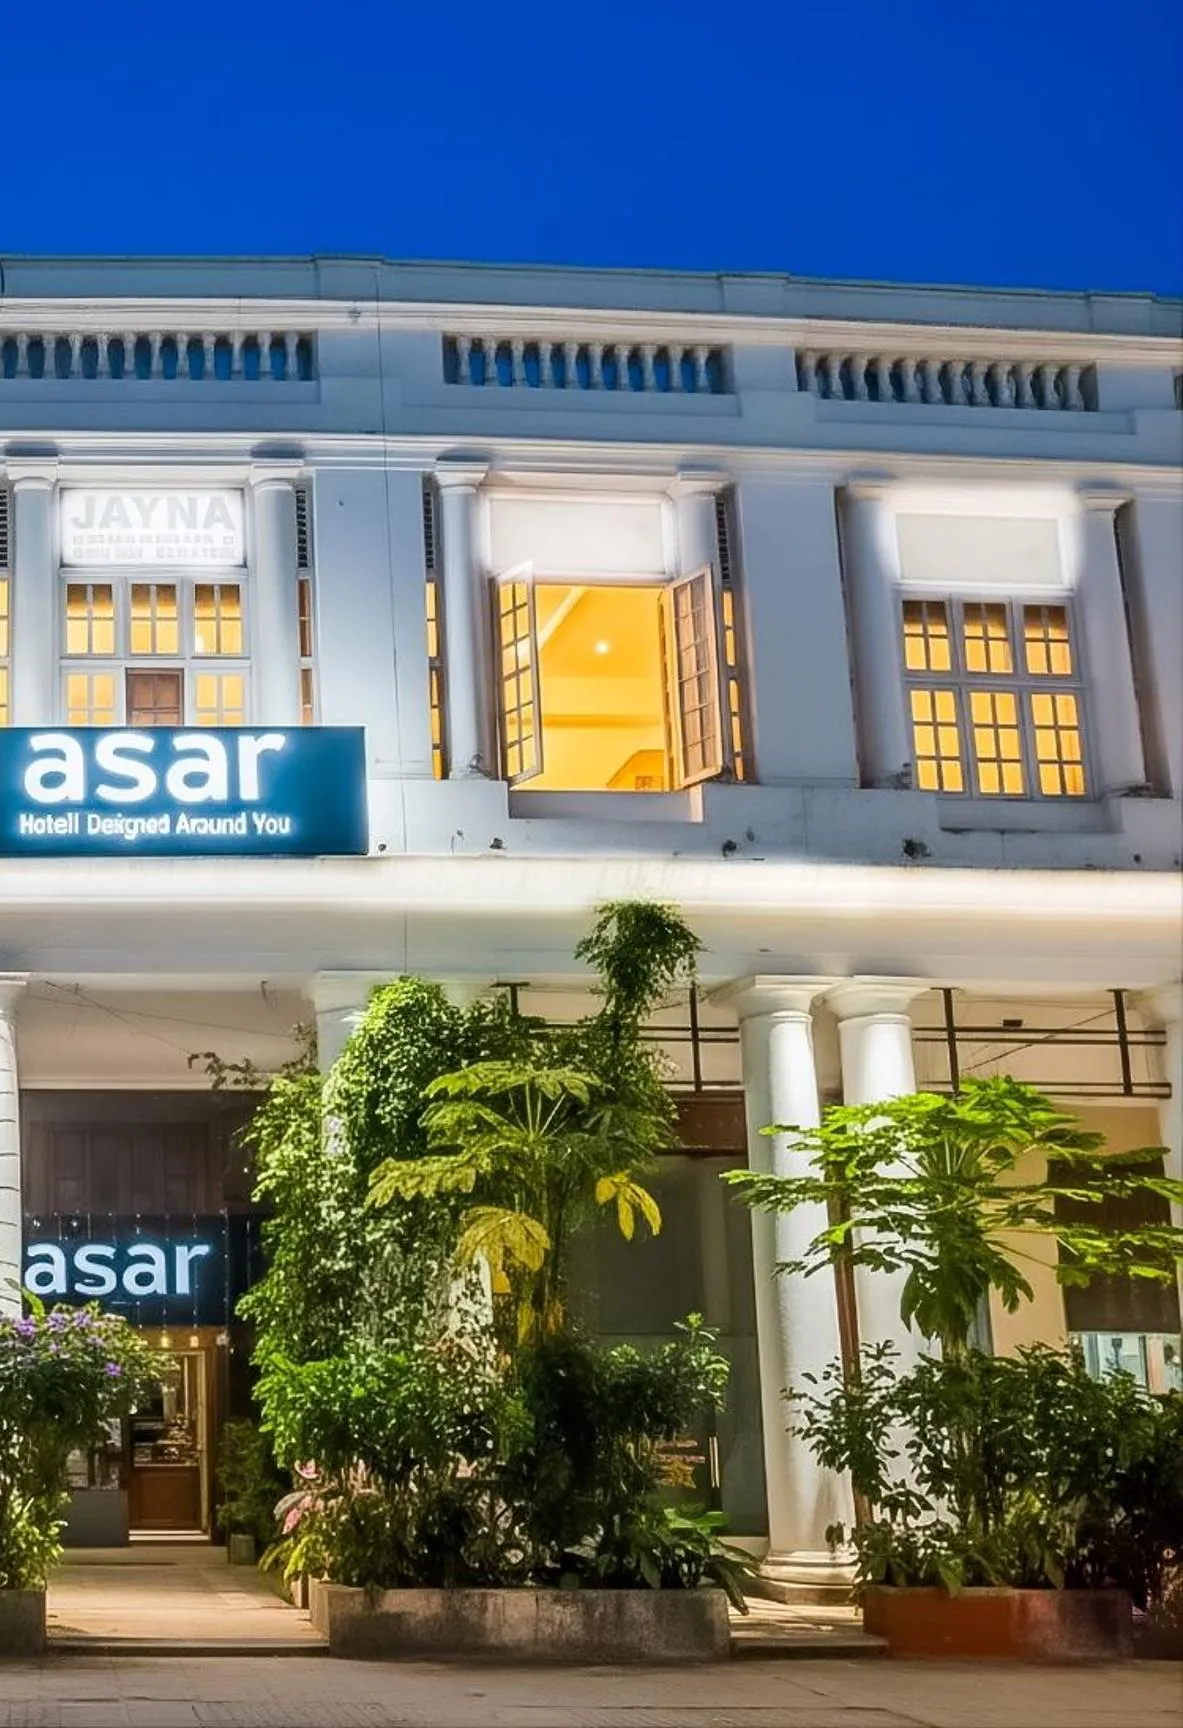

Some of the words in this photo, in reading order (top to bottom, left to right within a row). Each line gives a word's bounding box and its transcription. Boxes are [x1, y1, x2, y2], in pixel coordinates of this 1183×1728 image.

[72, 496, 236, 530] JAYNA
[24, 733, 286, 803] asar
[176, 812, 246, 834] Around
[252, 811, 290, 834] You
[24, 1243, 211, 1296] asar
